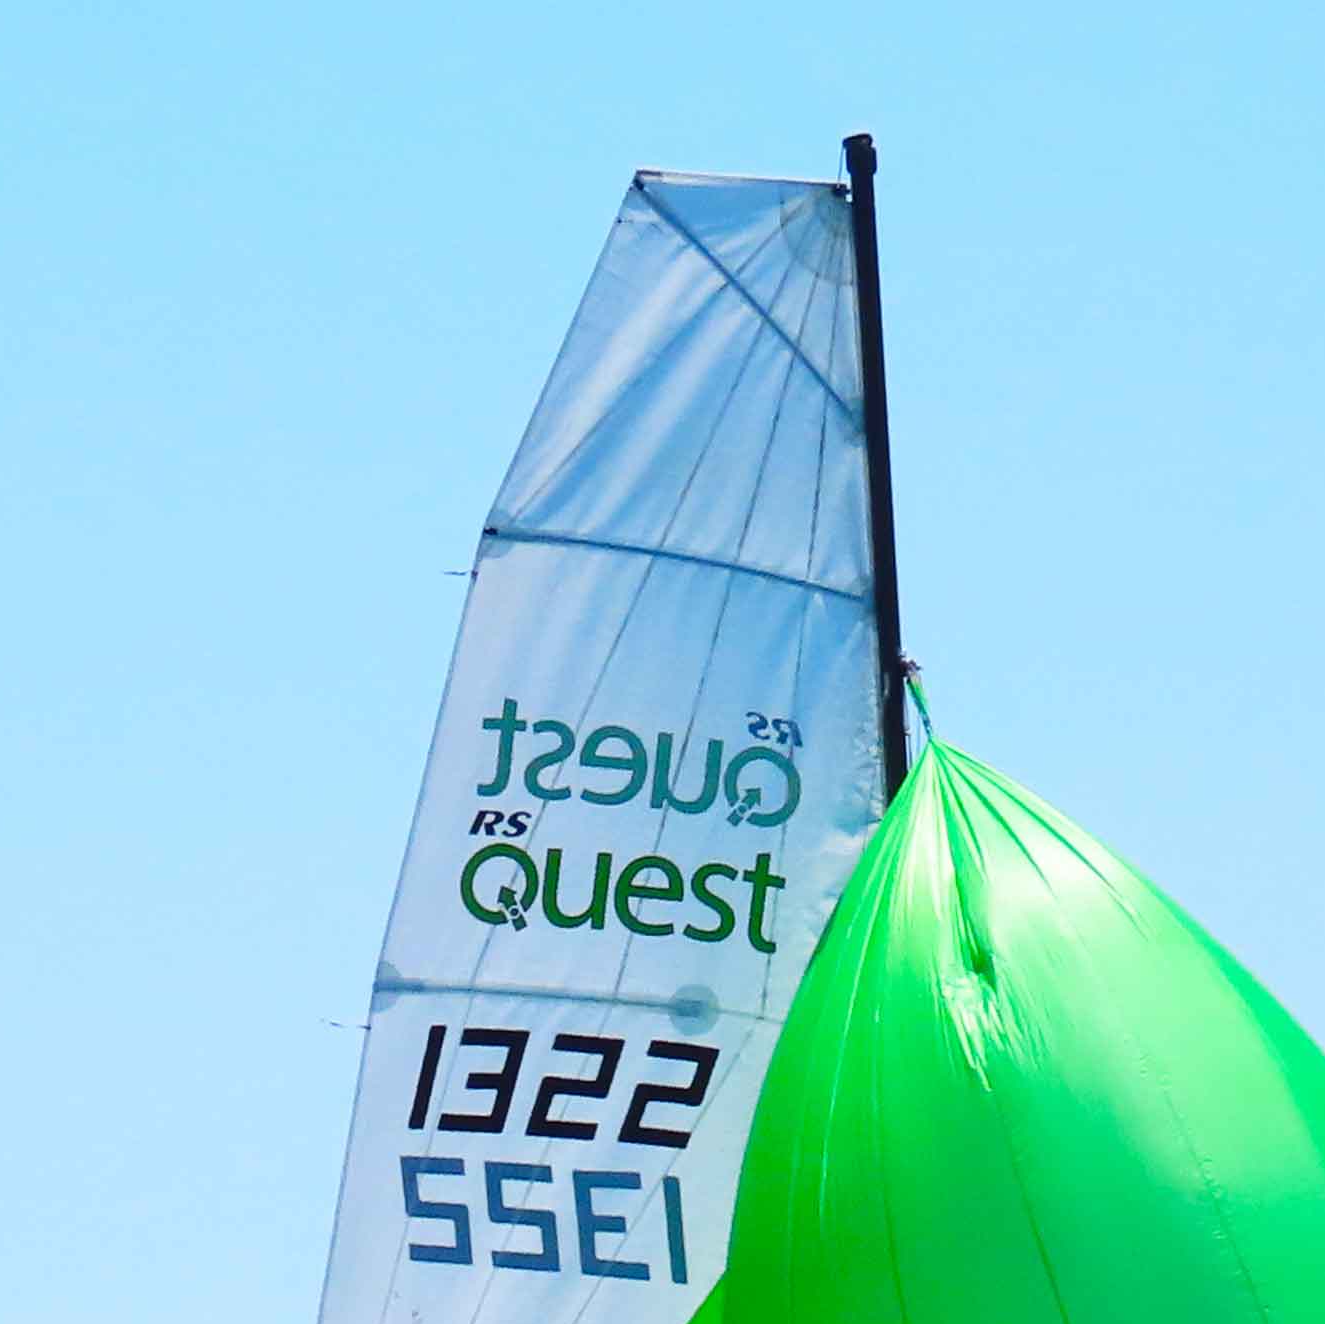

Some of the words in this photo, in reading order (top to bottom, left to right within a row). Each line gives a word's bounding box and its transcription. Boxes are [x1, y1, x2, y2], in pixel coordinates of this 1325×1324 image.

[468, 810, 532, 838] RS
[460, 842, 786, 954] Quest
[407, 1024, 720, 1150] 1322
